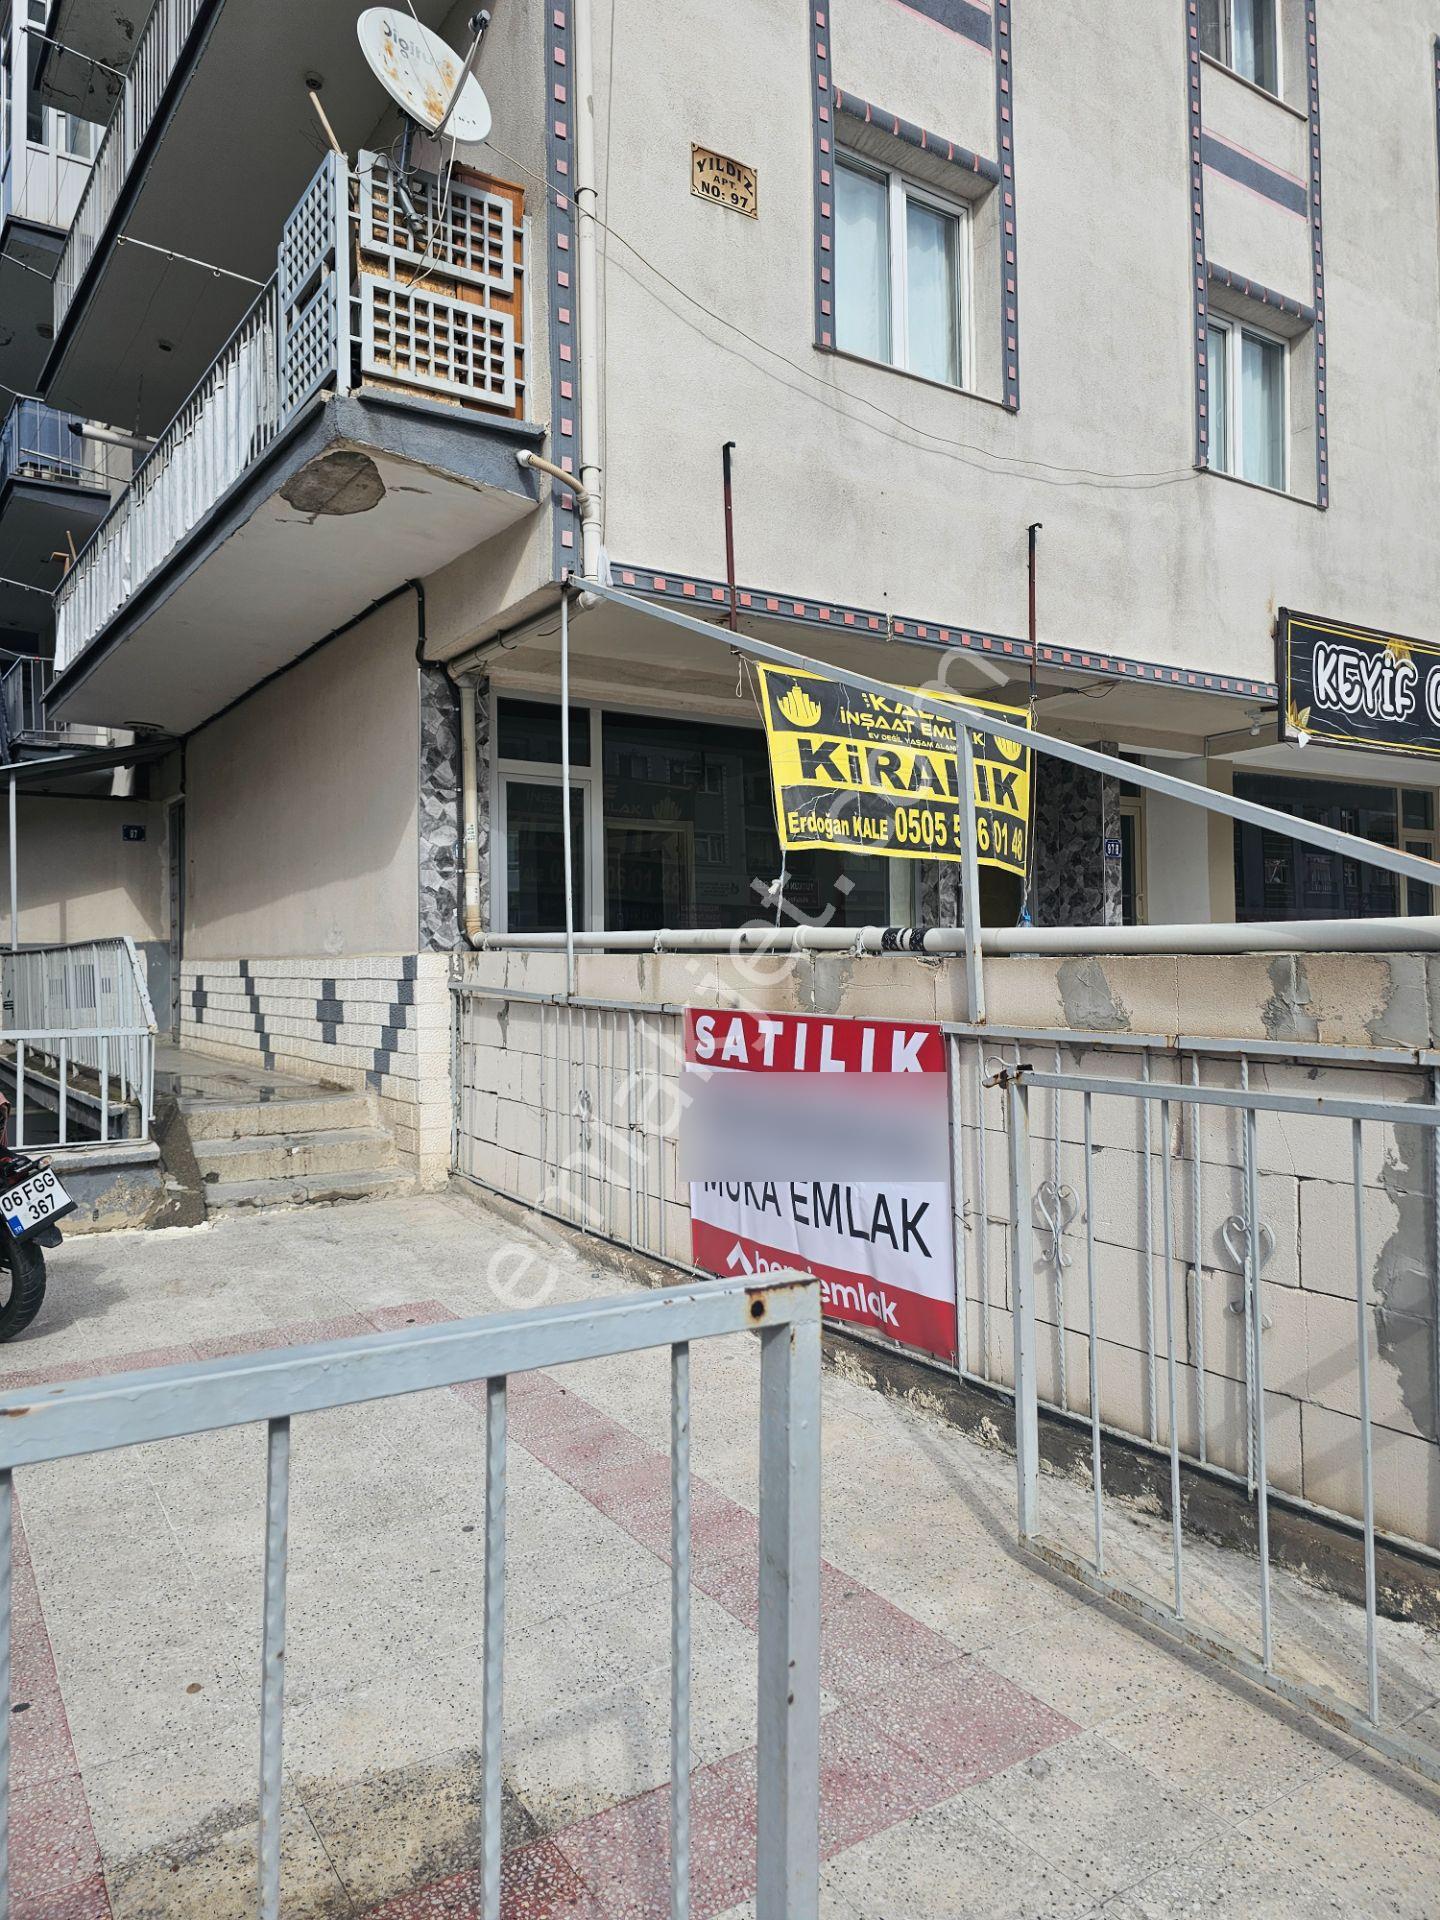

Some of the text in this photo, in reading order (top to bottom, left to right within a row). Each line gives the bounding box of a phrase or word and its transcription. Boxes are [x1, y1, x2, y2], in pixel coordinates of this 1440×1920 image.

[697, 157, 754, 197] YILDIZ
[701, 181, 749, 208] NO: 97
[713, 175, 737, 190] APT.
[839, 709, 986, 747] İNŞAAT EMLK
[868, 732, 880, 741] EV
[787, 806, 1023, 862] Erdoğan KALE 0505 56 01 48
[695, 1015, 930, 1073] SATILIK
[2, 1173, 55, 1212] 06 FGG
[28, 1193, 55, 1220] 367
[14, 1225, 23, 1234] TR
[790, 1181, 934, 1259] EMLAK
